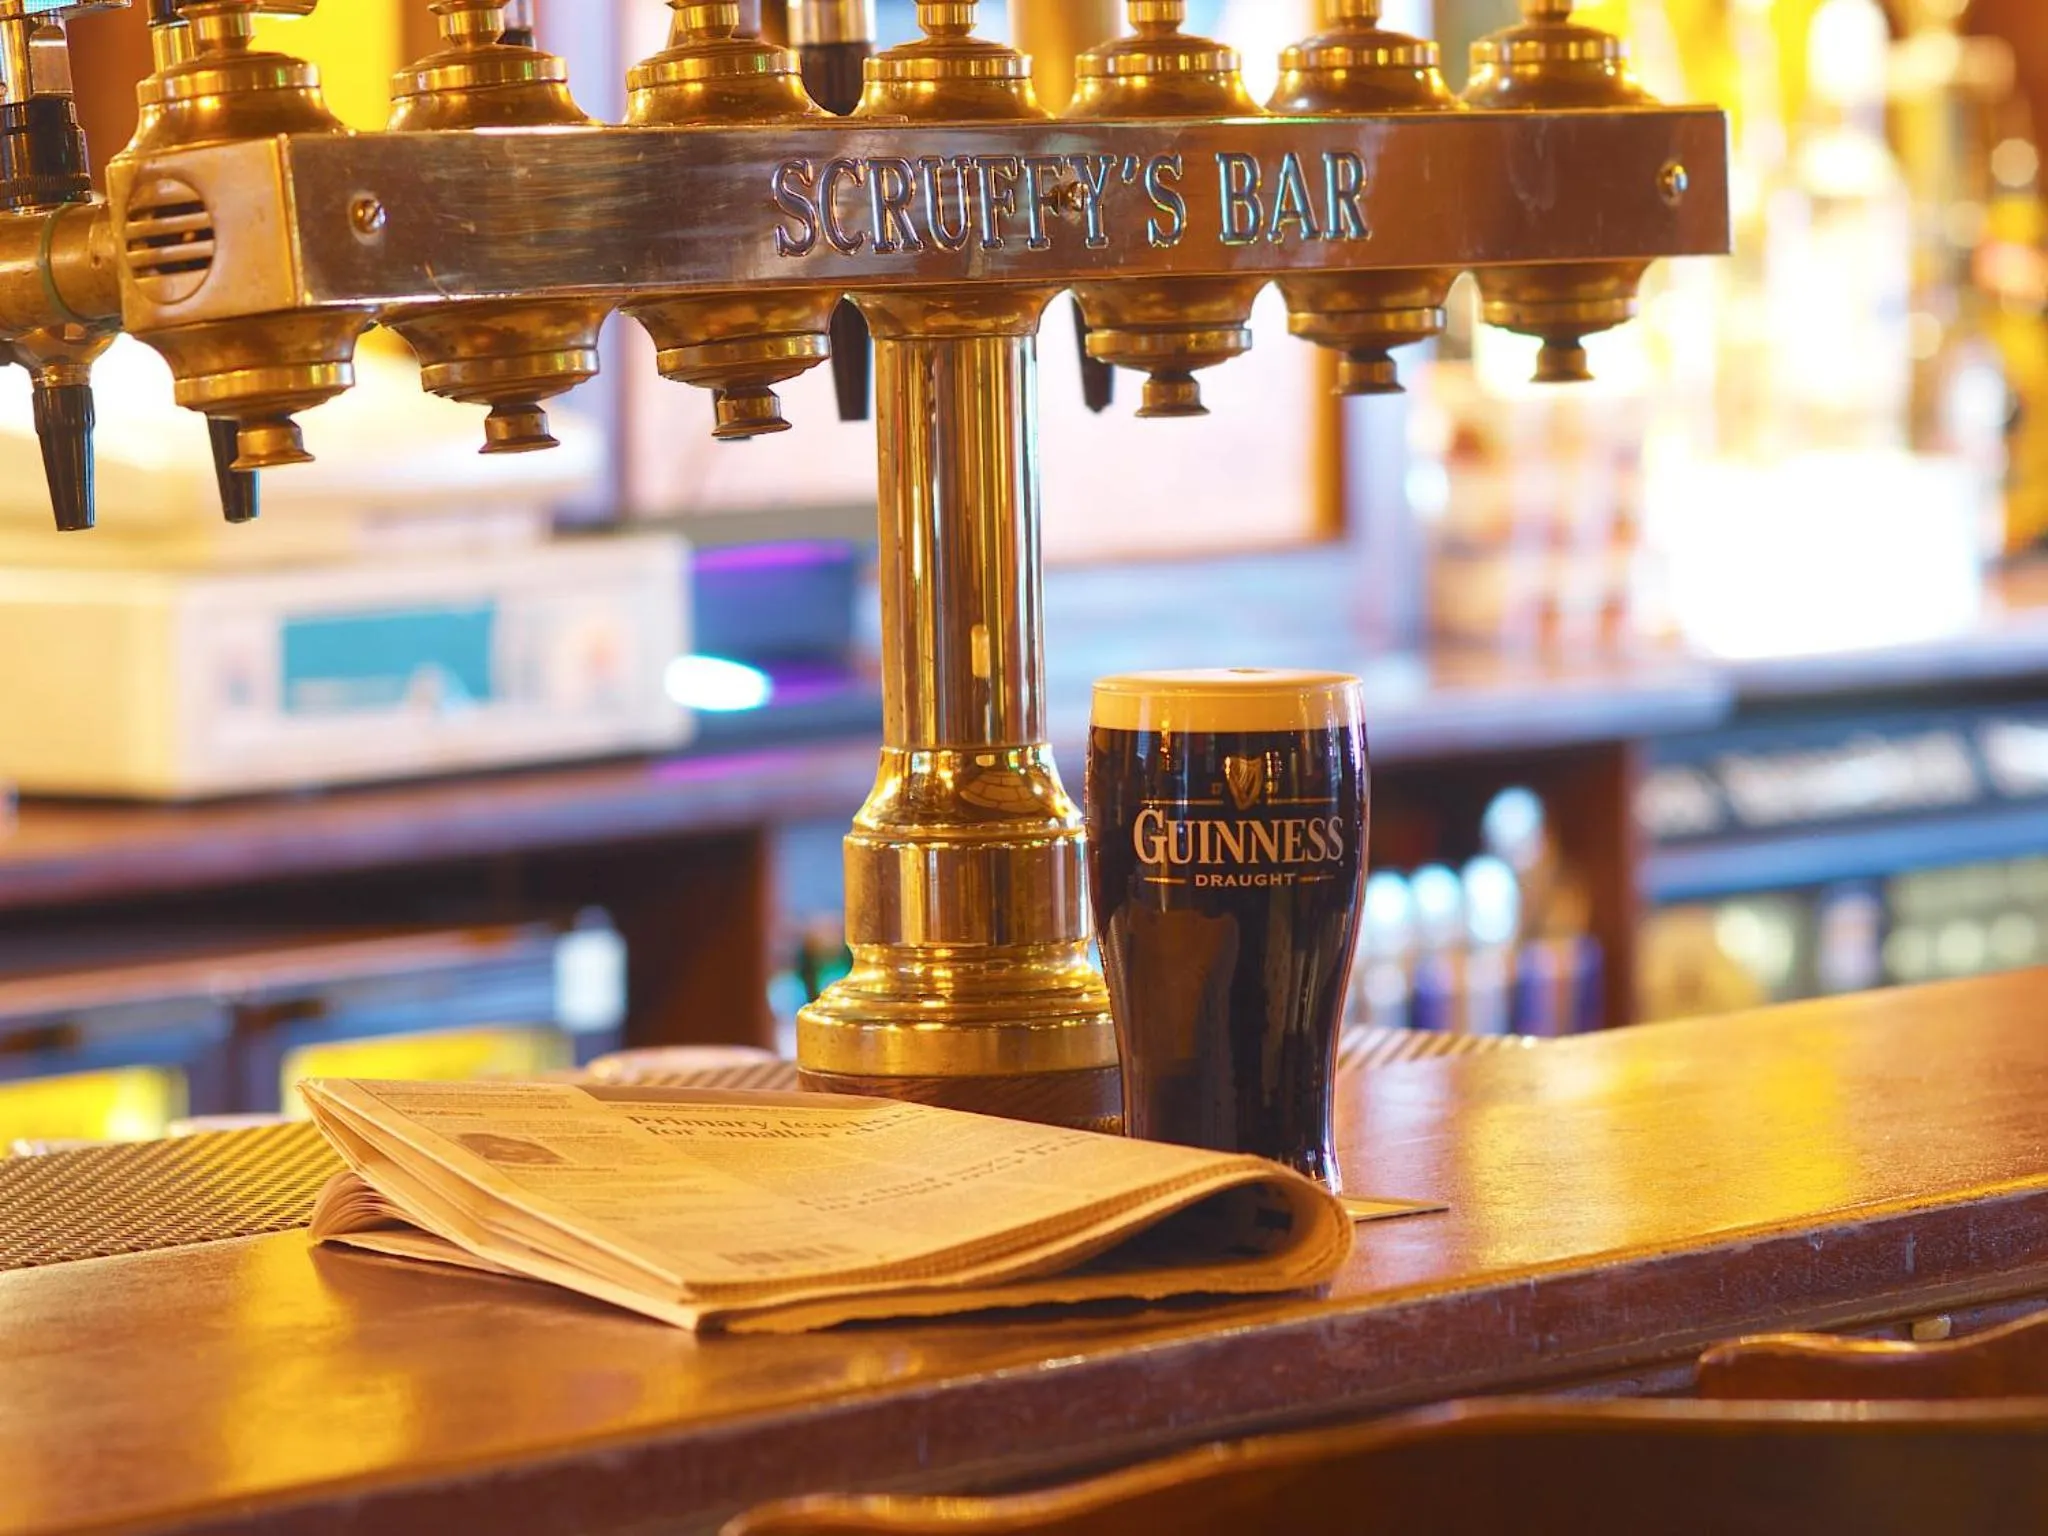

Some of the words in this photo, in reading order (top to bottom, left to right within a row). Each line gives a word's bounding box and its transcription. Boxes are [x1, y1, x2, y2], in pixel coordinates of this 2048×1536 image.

[772, 151, 1187, 256] SCRUFFY'S
[1216, 150, 1372, 246] BAR
[1133, 808, 1343, 865] GUINNESS
[1195, 873, 1296, 887] DRAUGHT
[624, 1115, 768, 1130] Primary
[644, 1126, 696, 1136] for
[707, 1129, 831, 1139] smaller
